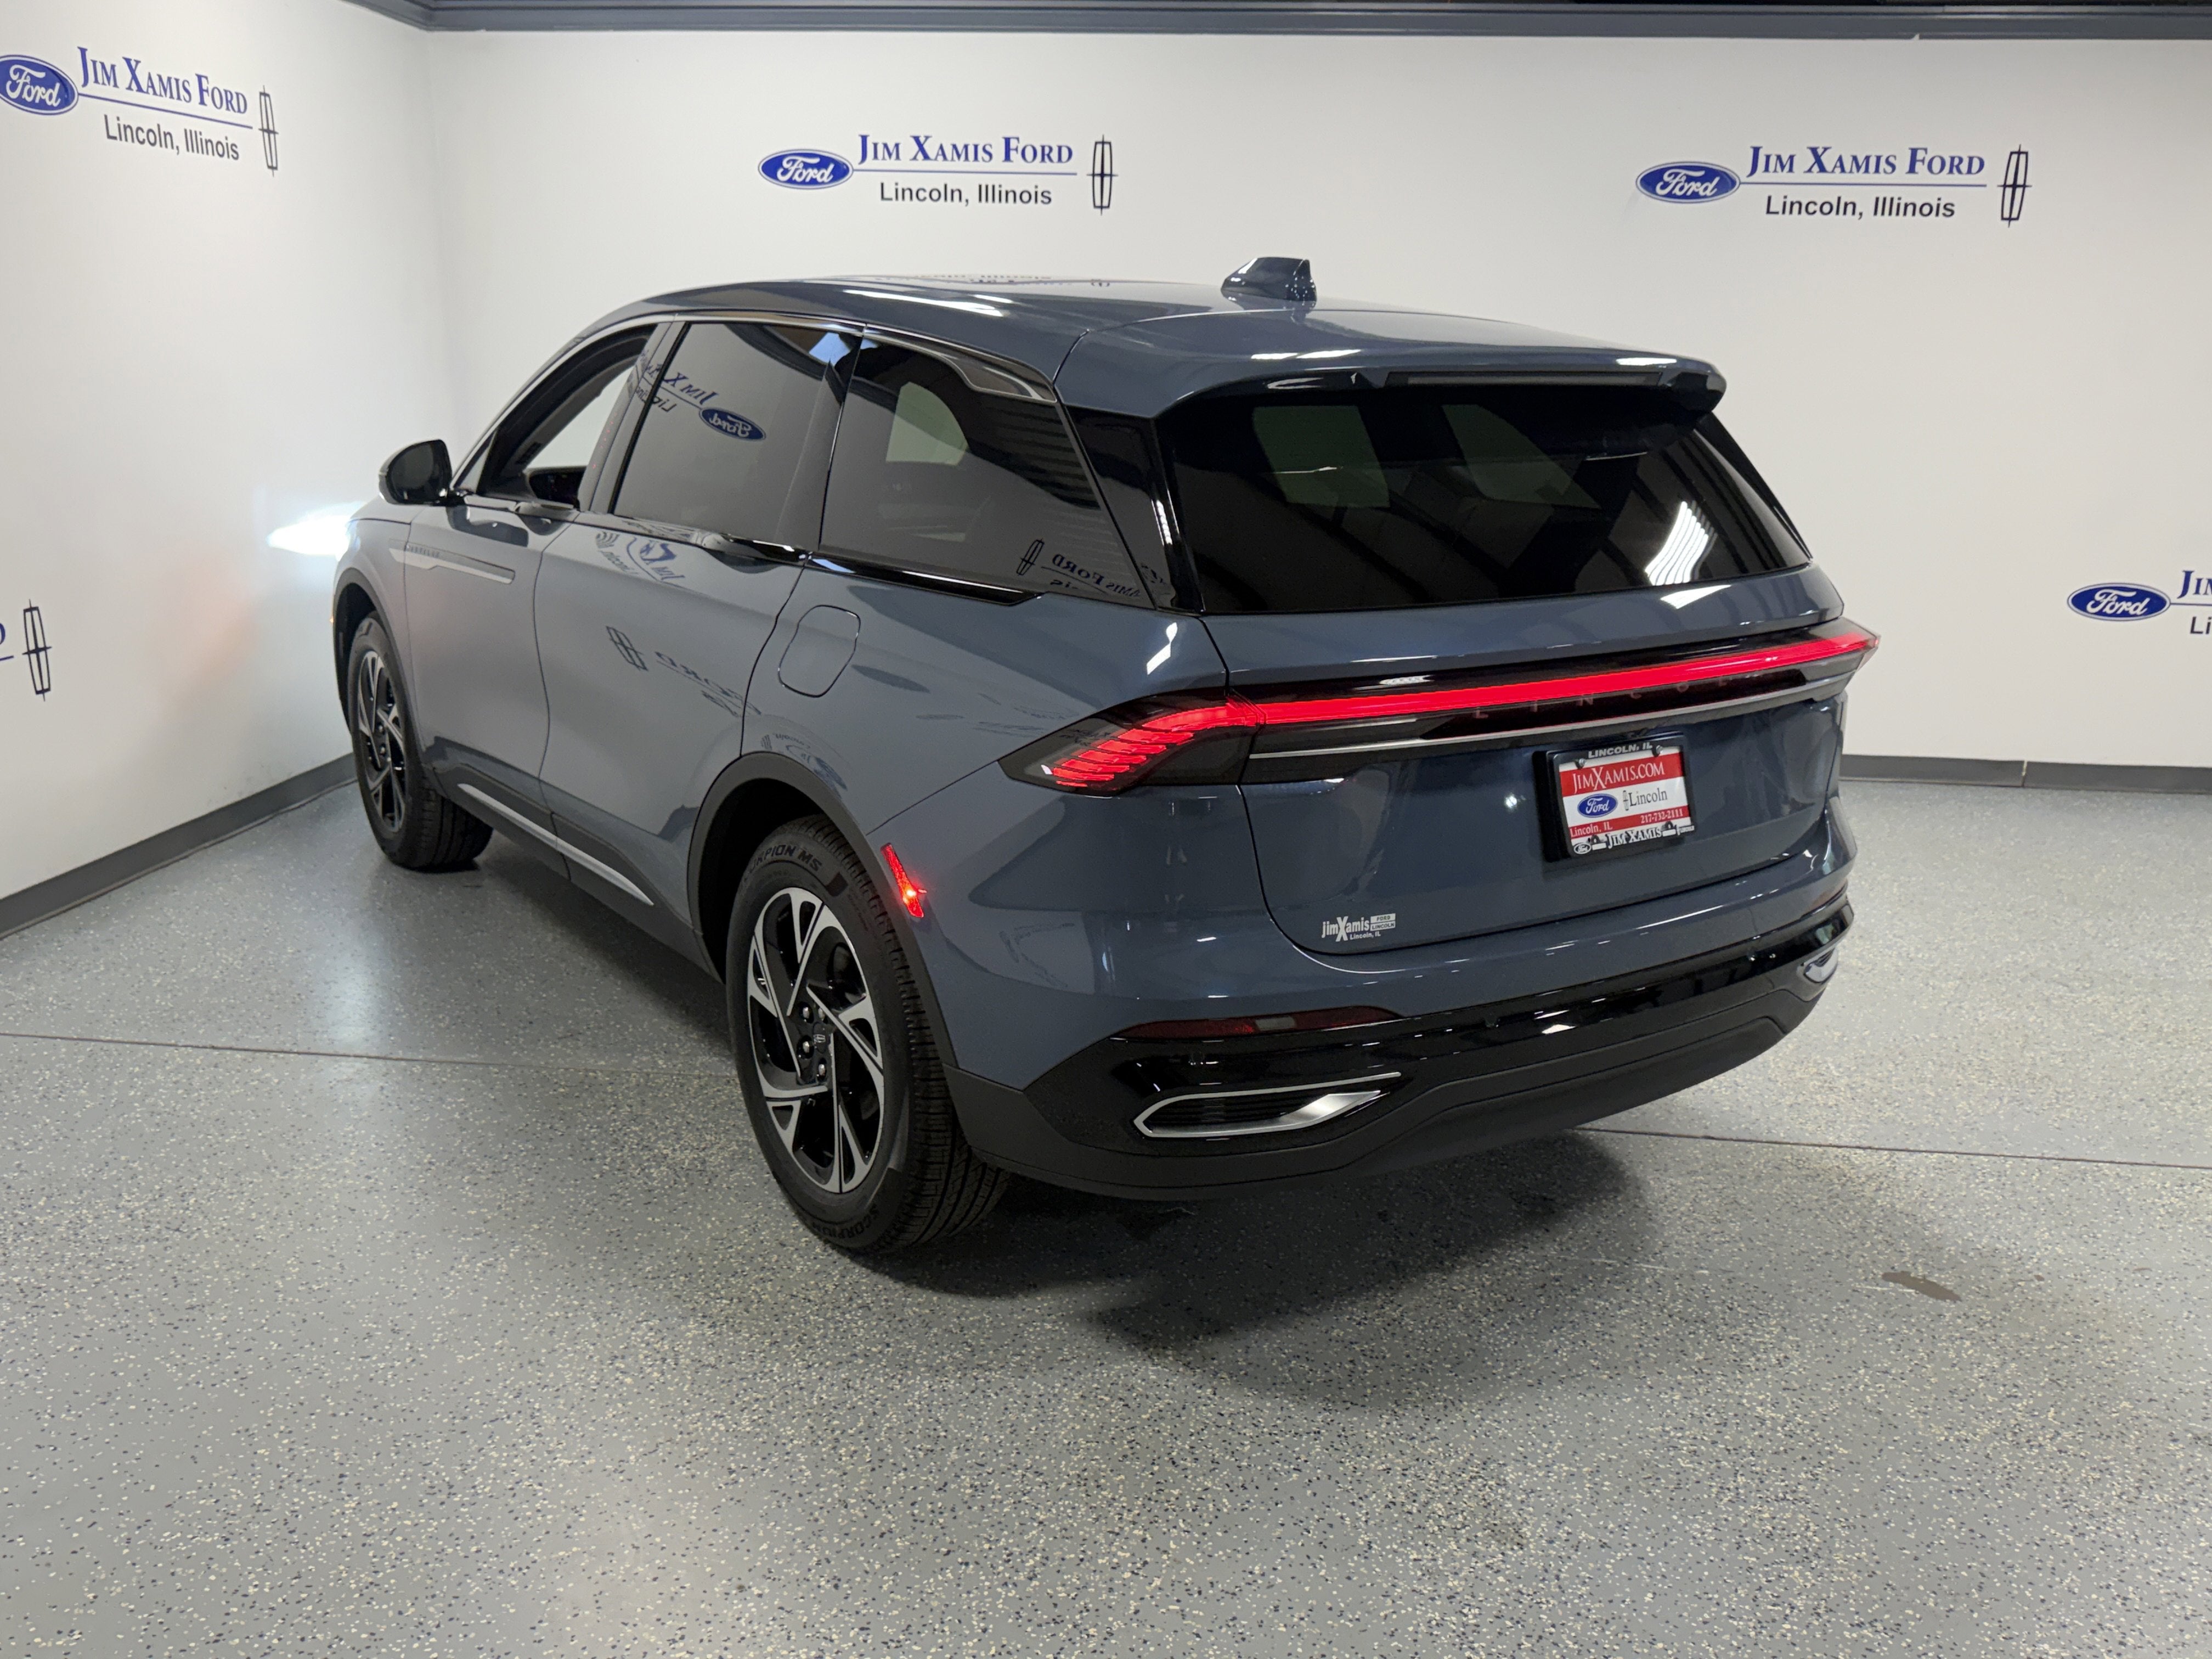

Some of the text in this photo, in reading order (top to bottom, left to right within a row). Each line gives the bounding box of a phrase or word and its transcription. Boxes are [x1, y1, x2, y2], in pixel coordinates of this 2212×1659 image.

[6, 65, 61, 107] Ford
[77, 47, 247, 114] JIM XAMIS FORD
[104, 114, 240, 161] Lincoln, Illinois
[857, 134, 1074, 165] JIM XAMIS FORD
[776, 156, 834, 184] Ford
[1746, 145, 1985, 178] JIM XAMIS FORD
[879, 182, 1052, 206] Lincoln, Illinois
[1655, 168, 1718, 198] Ford
[1765, 195, 1956, 219] Lincoln, Illinois
[2086, 589, 2151, 616] Ford
[1643, 742, 1653, 750] IL
[1572, 761, 1665, 794] JIMXAMIS.COM
[1585, 797, 1610, 814] Ford
[1628, 787, 1668, 806] Lincoln
[1570, 821, 1613, 837] Lincoln, IL
[1640, 808, 1684, 823] 217-732-2111
